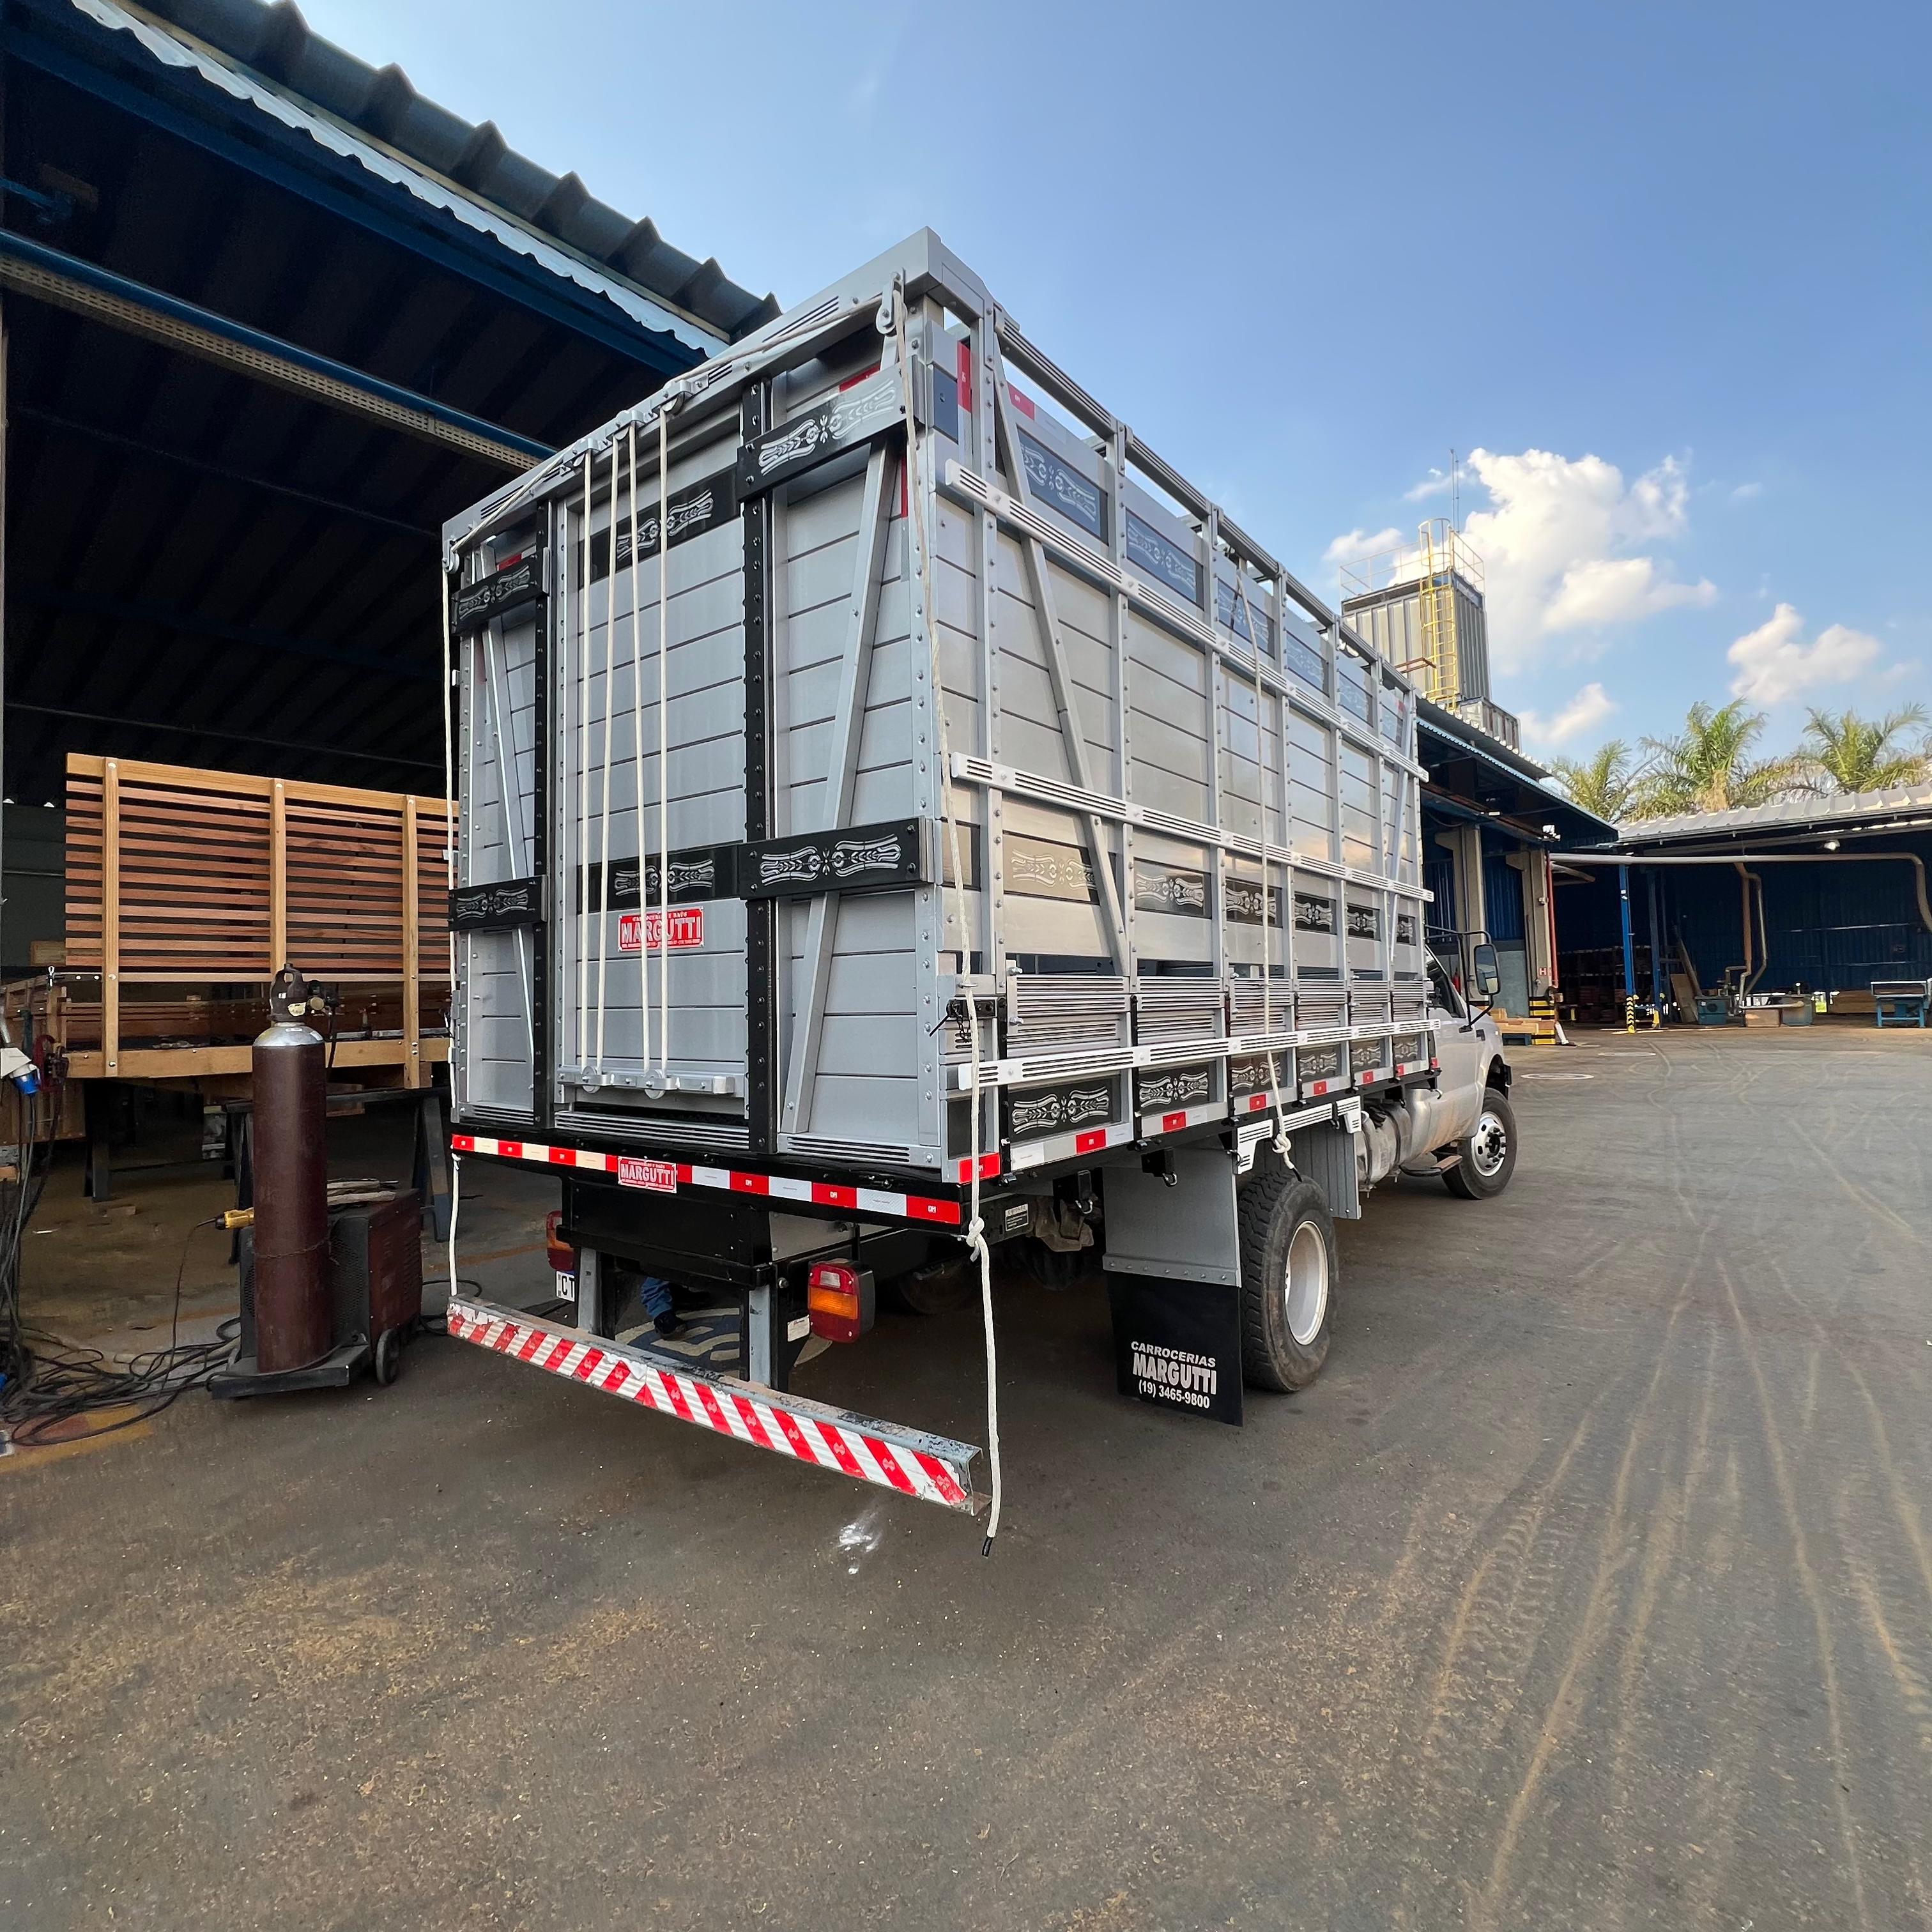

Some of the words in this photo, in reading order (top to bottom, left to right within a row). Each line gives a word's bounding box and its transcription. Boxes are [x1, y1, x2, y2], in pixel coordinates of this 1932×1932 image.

[622, 916, 701, 944] MARGUTTI
[1539, 967, 1547, 976] H
[621, 1163, 674, 1186] MARGUTTI
[1131, 1341, 1216, 1367] CARROCERIAS
[1133, 1352, 1216, 1395] MARGUTTI
[1139, 1379, 1156, 1398] (19)
[1158, 1384, 1209, 1409] 3465-9800
